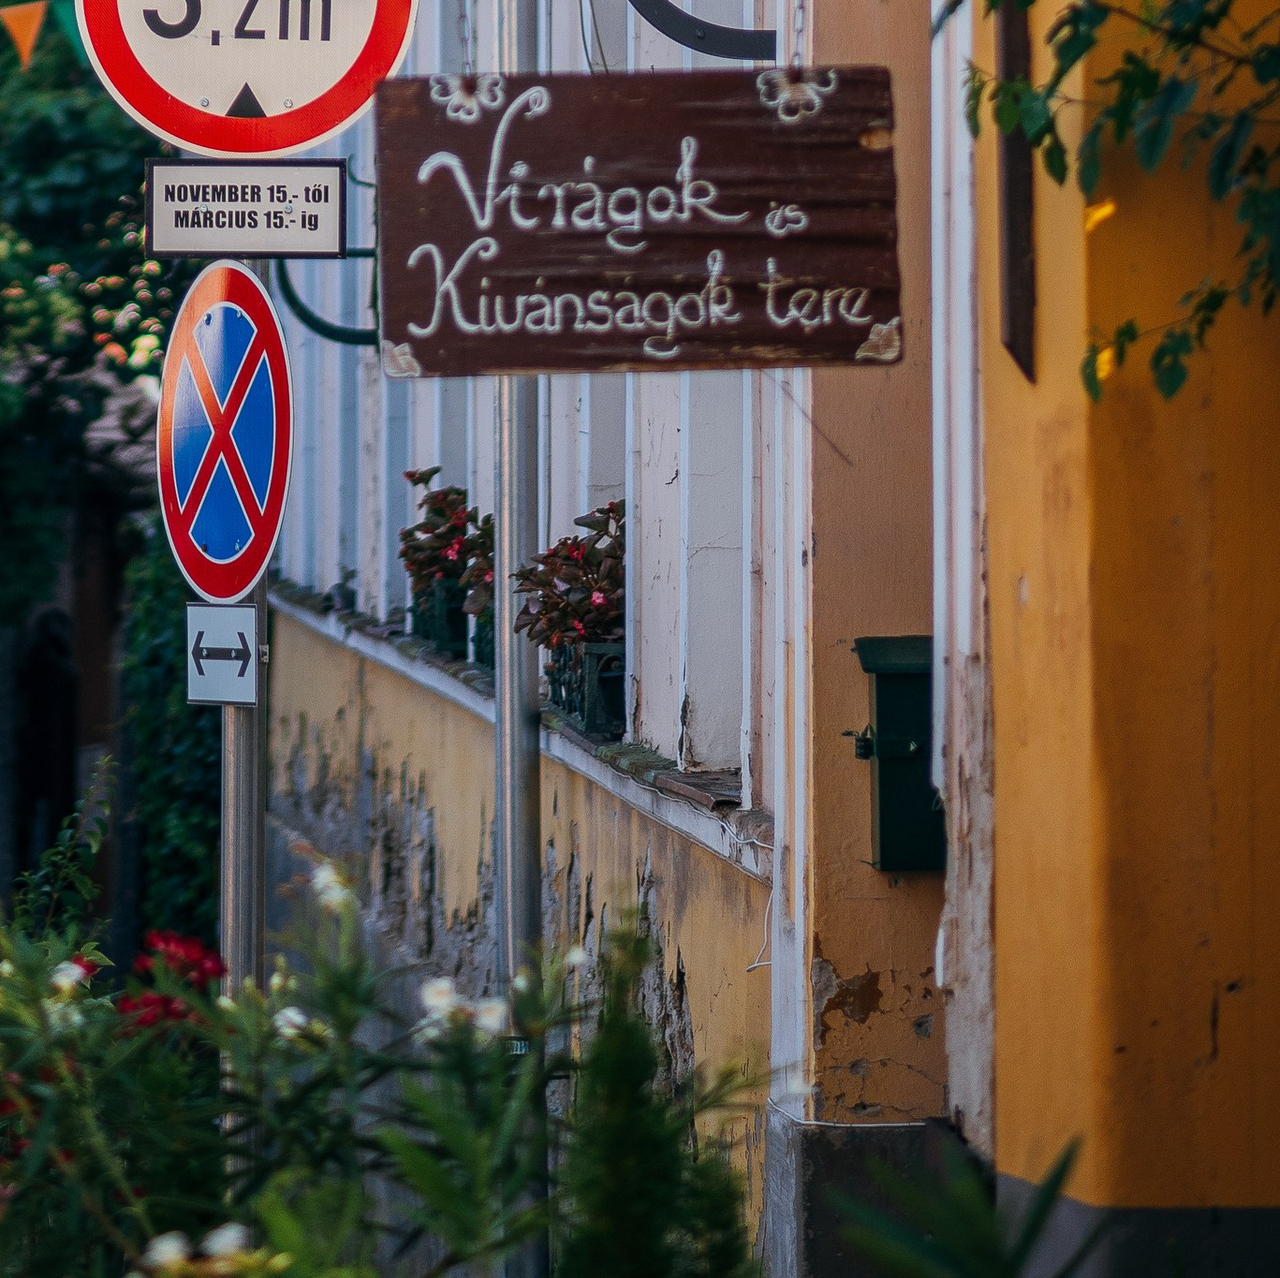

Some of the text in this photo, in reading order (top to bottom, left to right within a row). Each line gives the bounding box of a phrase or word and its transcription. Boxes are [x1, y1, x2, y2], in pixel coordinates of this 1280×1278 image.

[417, 85, 751, 253] Virágok
[164, 184, 262, 203] NOVEMBER
[303, 183, 330, 203] től
[173, 206, 259, 229] MÁRCIUS
[301, 210, 319, 231] ig
[757, 257, 873, 327] tere
